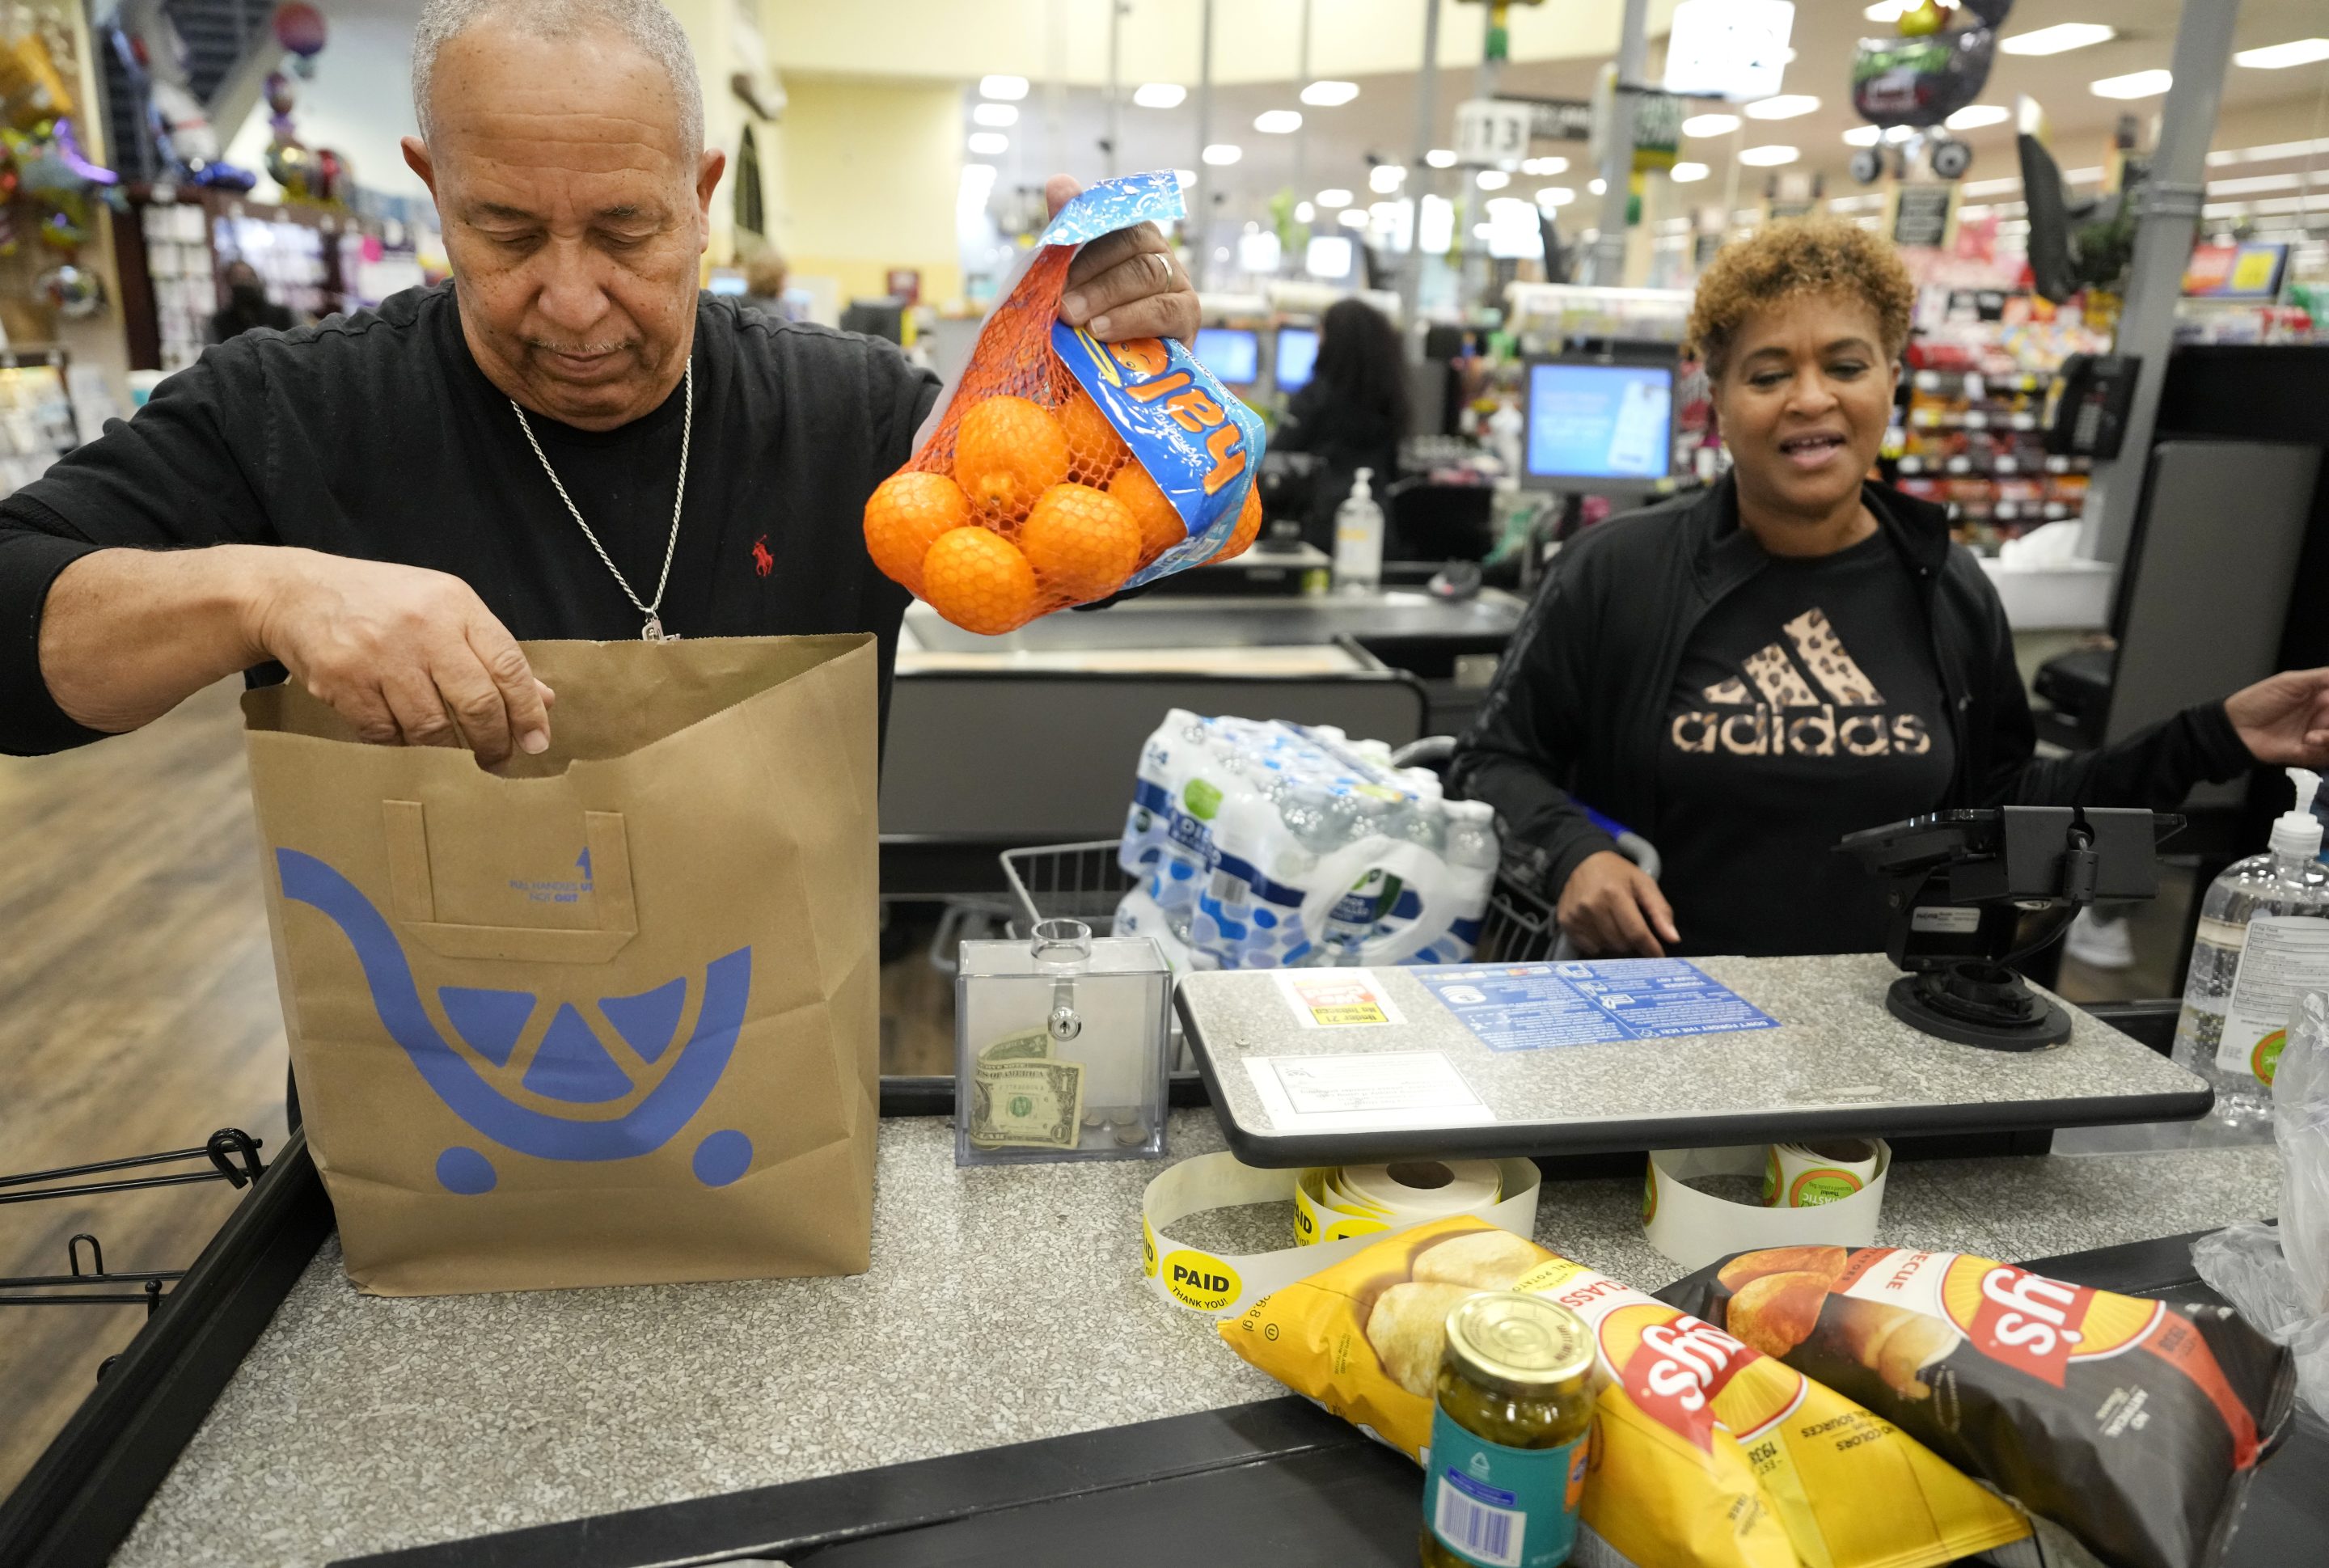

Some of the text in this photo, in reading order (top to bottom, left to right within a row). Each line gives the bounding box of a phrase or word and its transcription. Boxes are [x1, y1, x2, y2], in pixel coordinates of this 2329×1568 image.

[1672, 703, 1931, 756] adidas
[554, 893, 579, 902] OUT
[1701, 1023, 1738, 1031] FORGET
[1739, 1021, 1769, 1029] DON'T
[1294, 1203, 1312, 1235] AID
[1173, 1264, 1229, 1293] PAID
[1173, 1286, 1229, 1309] THANK YOU!
[1800, 1413, 1854, 1438] SOURCES
[1836, 1429, 1882, 1452] COLORS
